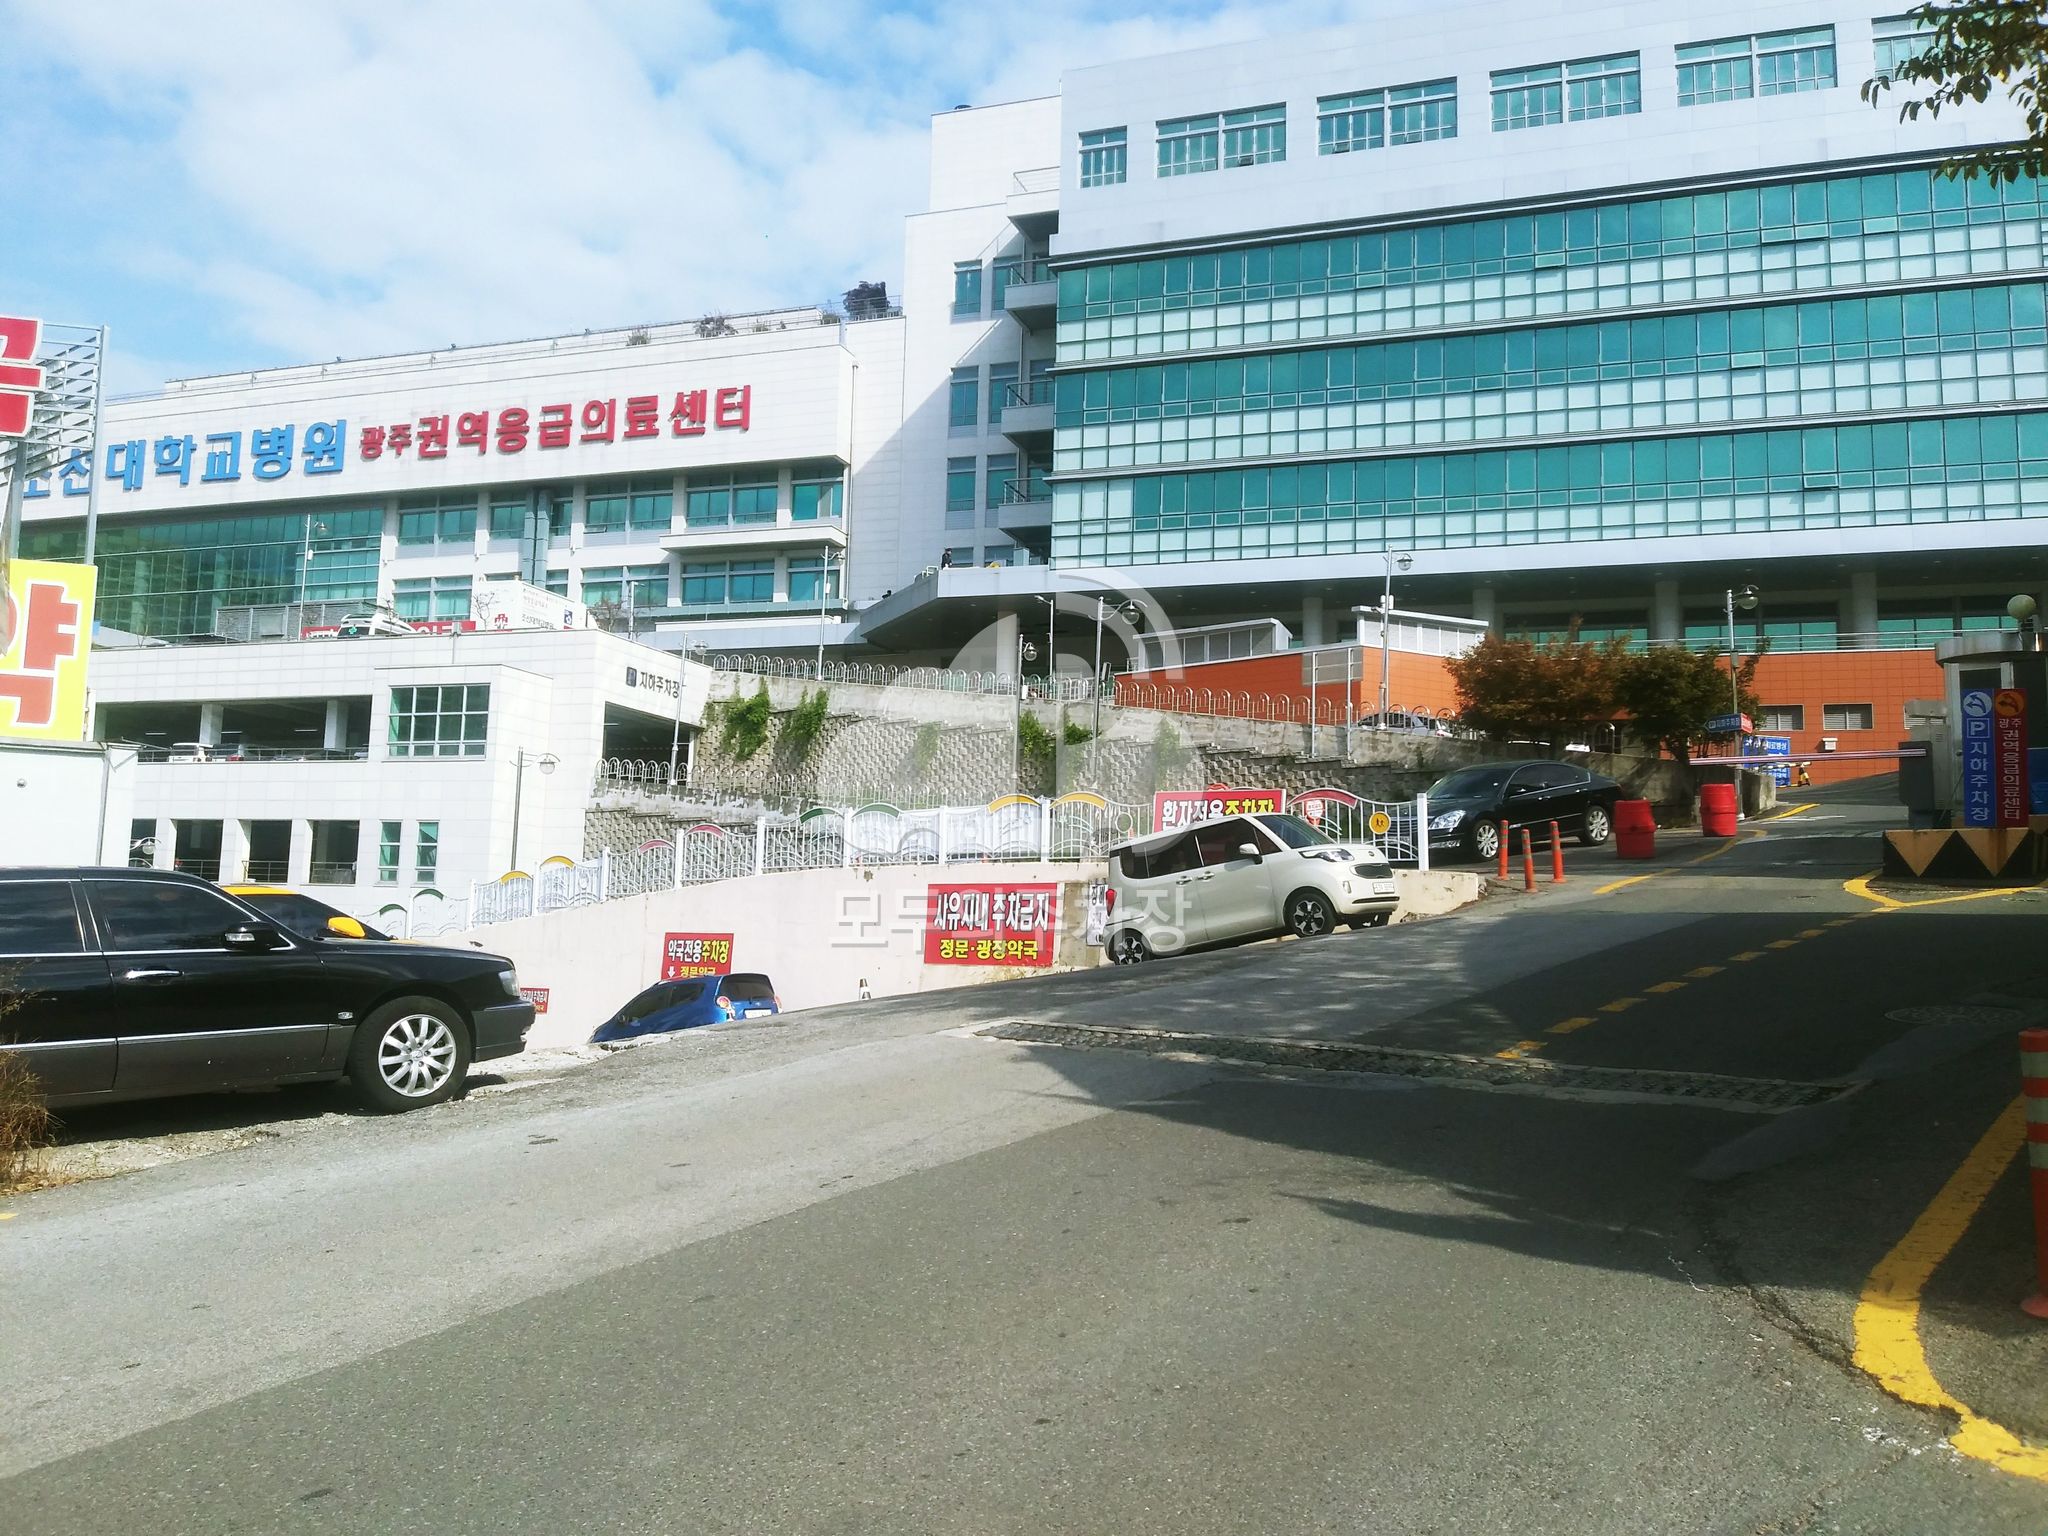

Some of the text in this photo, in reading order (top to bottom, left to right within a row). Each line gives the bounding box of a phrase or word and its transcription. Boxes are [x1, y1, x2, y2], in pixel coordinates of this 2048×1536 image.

[640, 671, 680, 699] 지하주차장
[1999, 718, 2022, 729] 광주
[1969, 741, 1990, 821] 지하주차장
[2002, 730, 2021, 820] 권역응급의료센터
[934, 892, 990, 931] 사유지내
[992, 892, 1050, 931] 주차금지
[668, 939, 729, 963] 약국전용주차장
